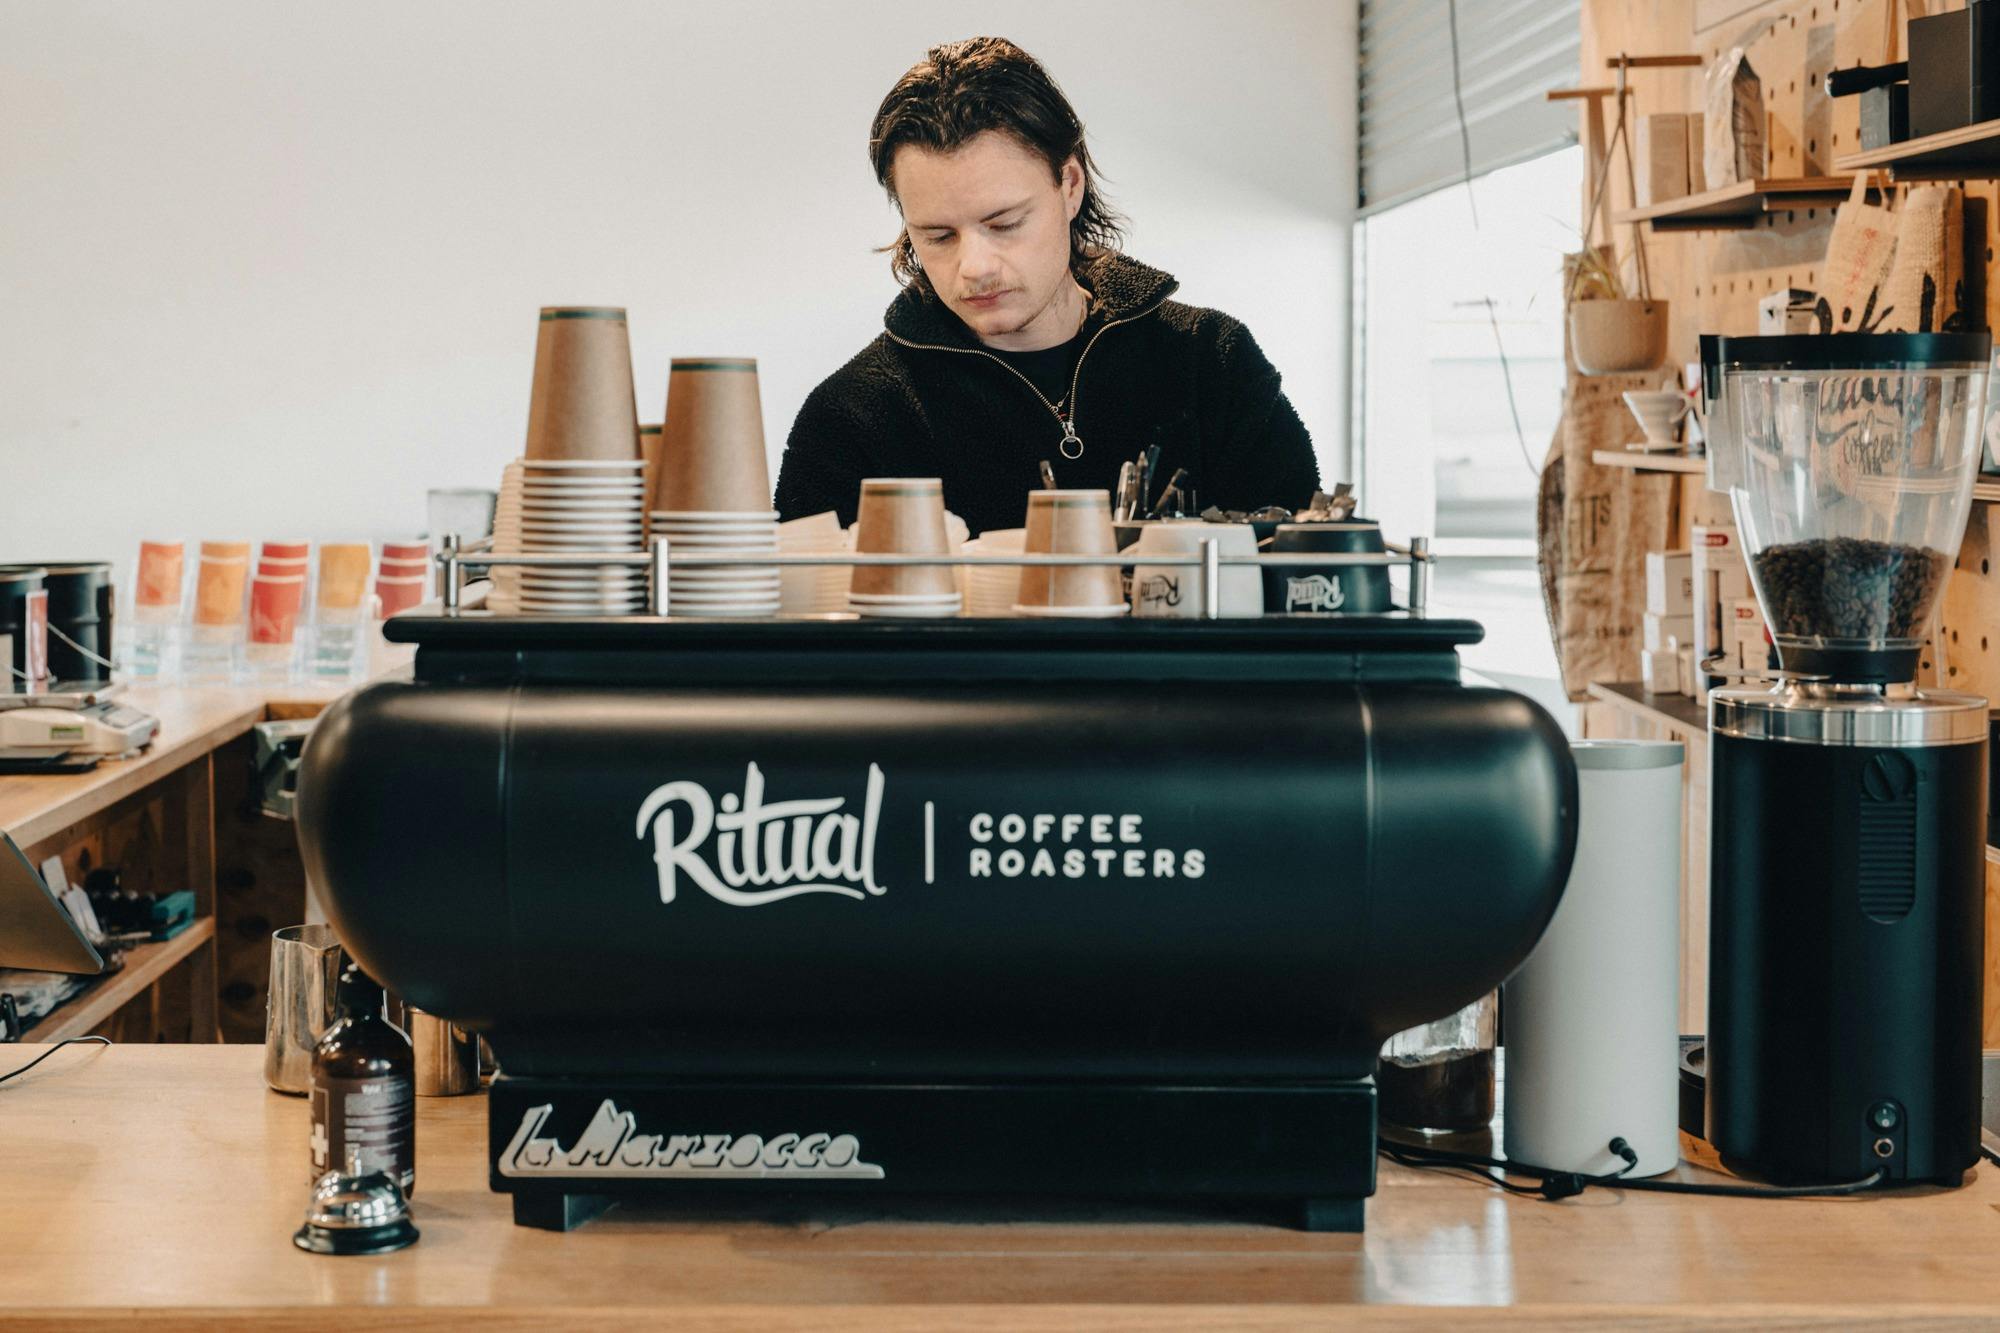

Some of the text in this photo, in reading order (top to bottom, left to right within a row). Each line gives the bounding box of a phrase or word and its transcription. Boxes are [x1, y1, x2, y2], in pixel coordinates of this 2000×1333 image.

[636, 761, 888, 907] Ritual
[969, 813, 1144, 844] COFFEE
[969, 848, 1206, 879] ROASTERS
[567, 1098, 866, 1174] Marzocco
